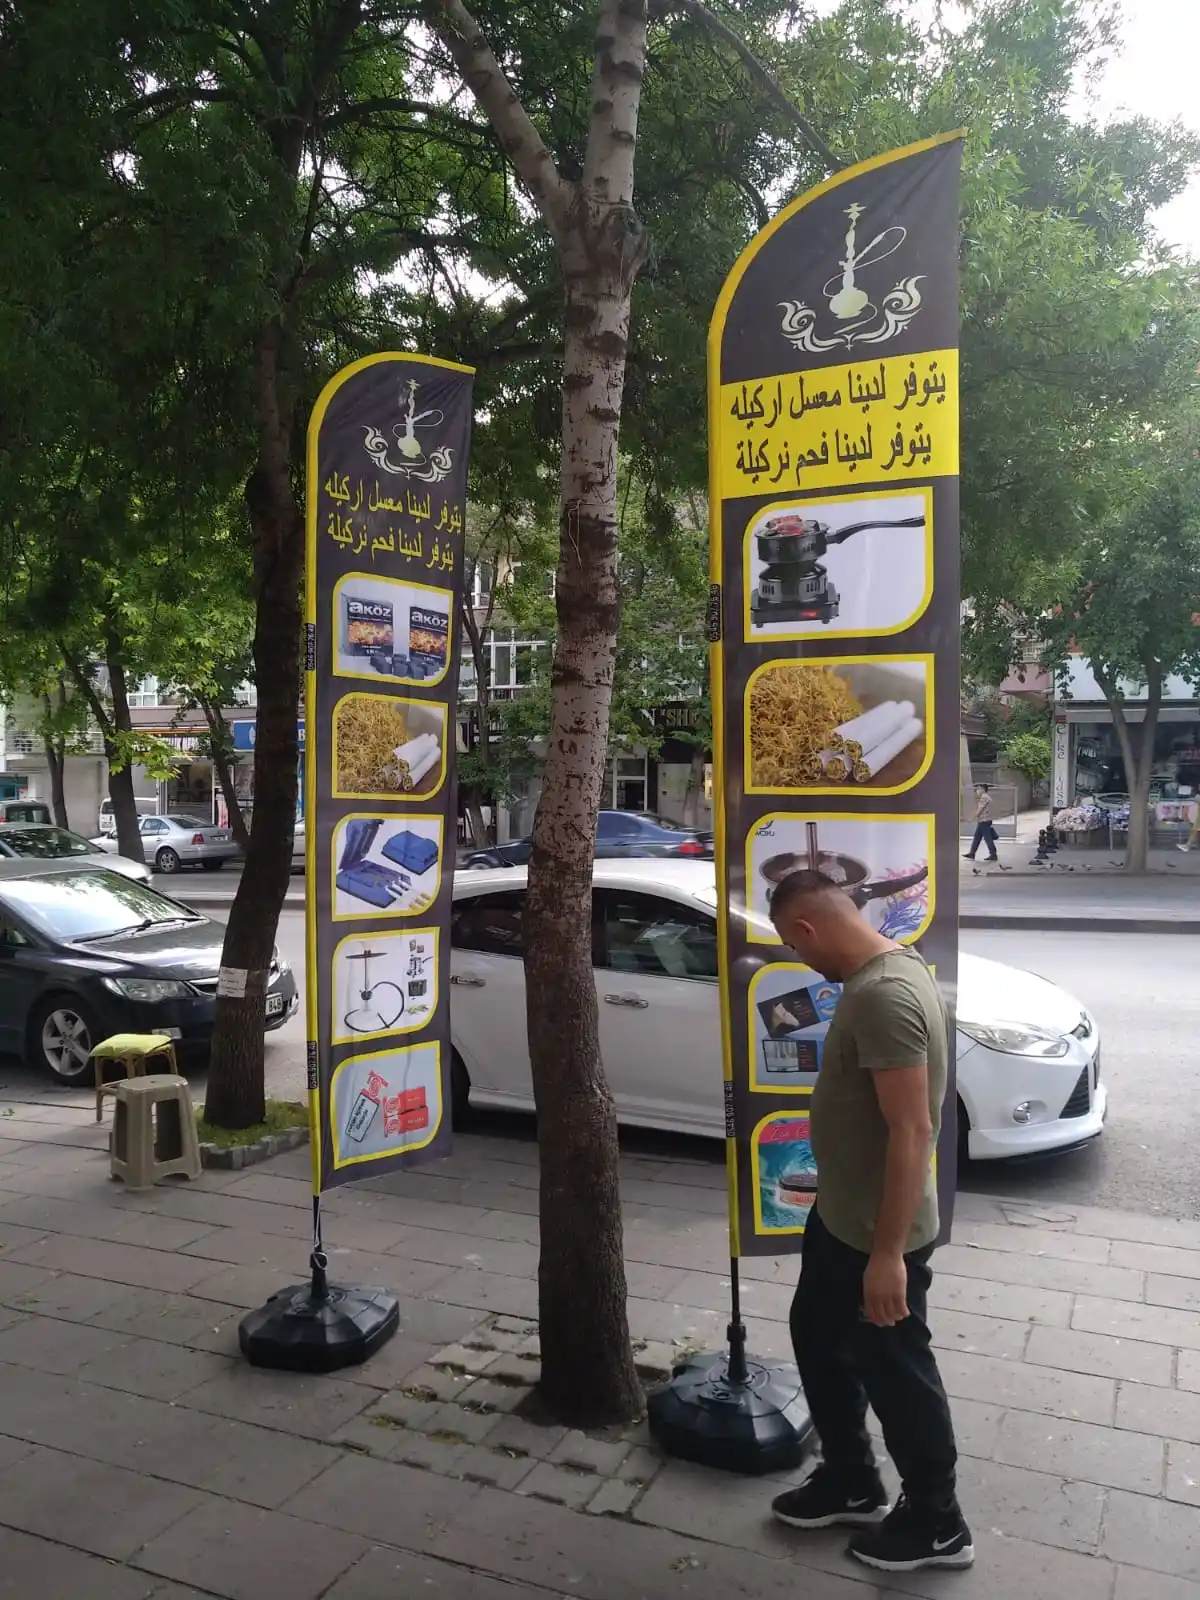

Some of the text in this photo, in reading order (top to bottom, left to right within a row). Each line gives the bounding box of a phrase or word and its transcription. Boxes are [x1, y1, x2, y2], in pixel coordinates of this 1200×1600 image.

[790, 375, 842, 419] معسل
[848, 362, 886, 414] لدينا
[894, 361, 946, 410] يتوفر
[735, 422, 932, 487] يتوفر لدينا فحم نركيلة
[368, 479, 403, 513] معسل
[406, 489, 431, 524] لدينا
[434, 500, 462, 535] يتوفر
[371, 526, 395, 563] فحم
[398, 528, 422, 563] لدينا
[425, 537, 454, 571] يتوفر
